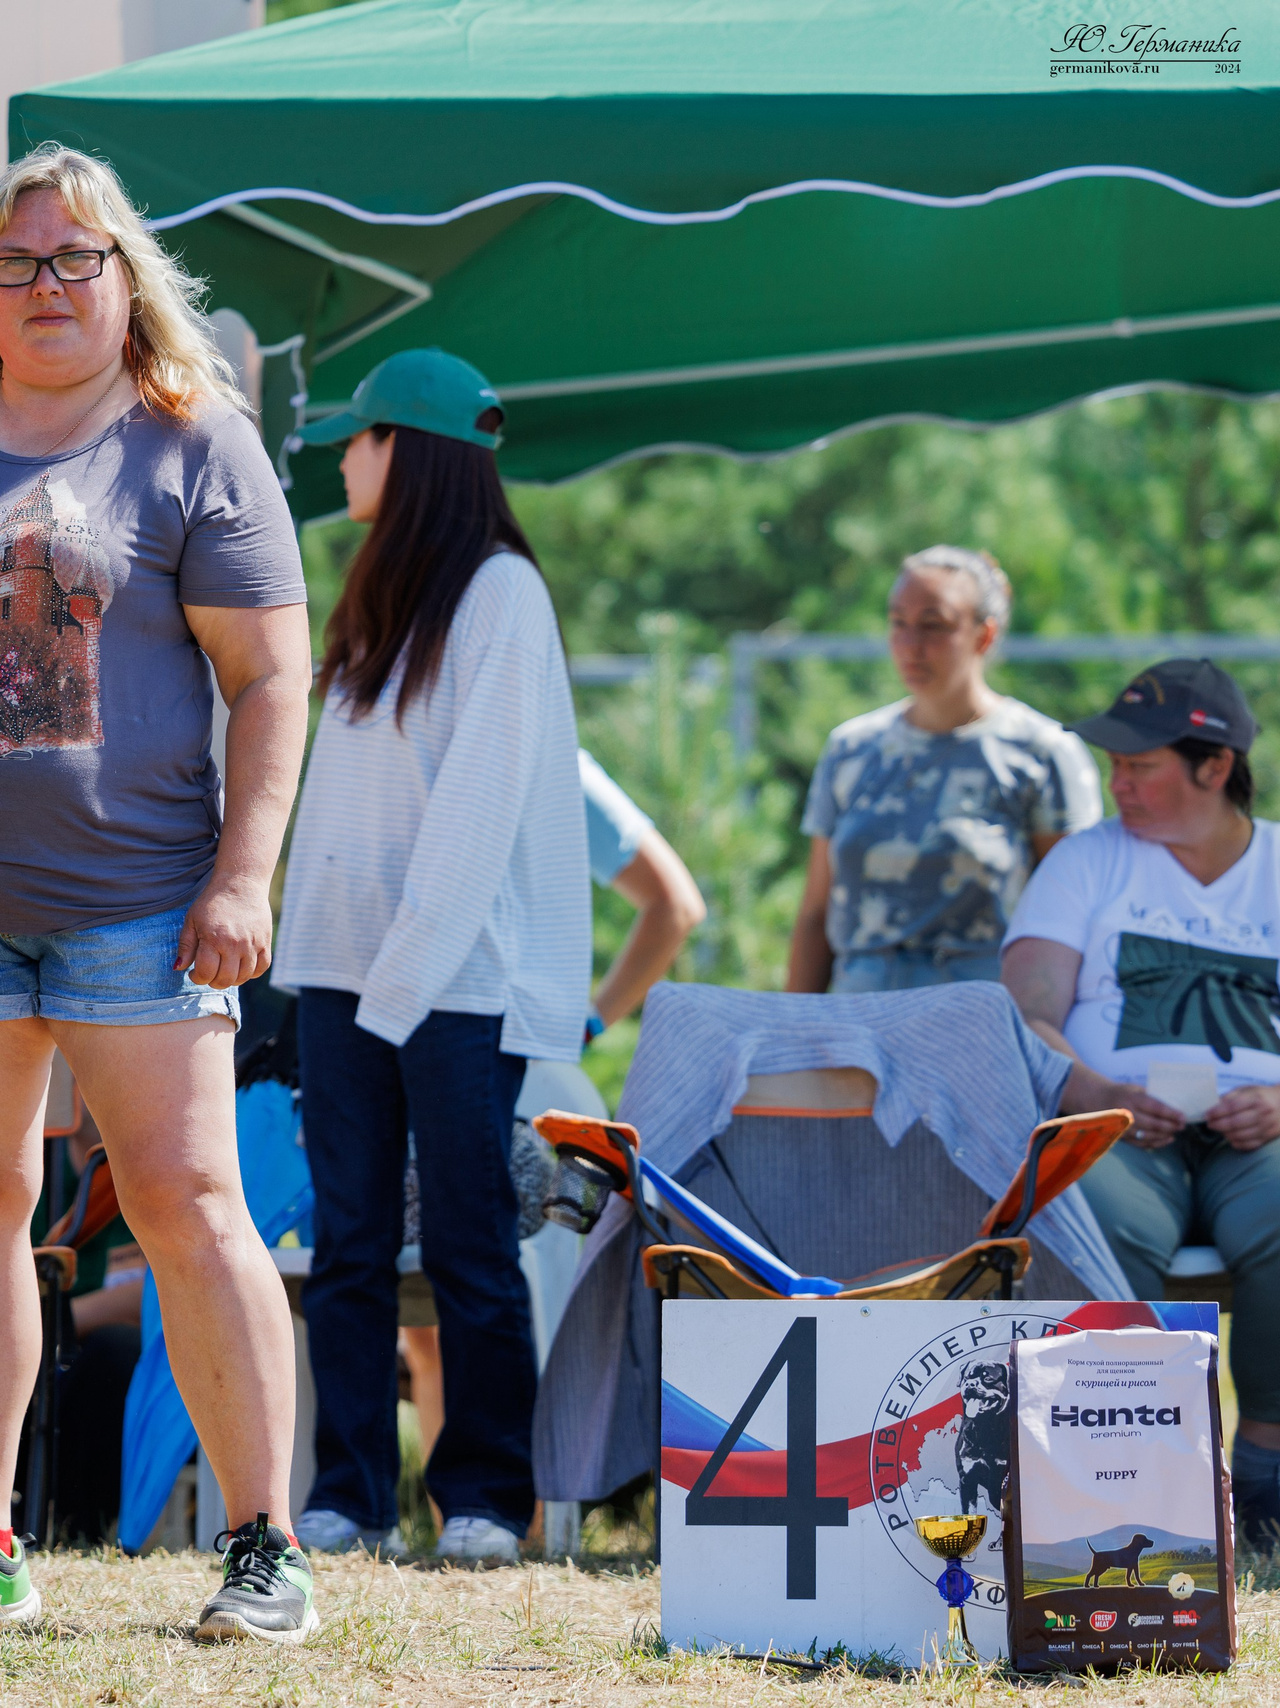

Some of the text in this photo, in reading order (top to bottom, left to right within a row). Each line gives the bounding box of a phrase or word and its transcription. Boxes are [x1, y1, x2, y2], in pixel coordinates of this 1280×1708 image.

[1067, 1358, 1085, 1366] Корм
[1081, 1378, 1120, 1388] курицей
[1128, 1379, 1157, 1388] рисом
[1051, 1405, 1181, 1427] Hanta
[875, 1325, 987, 1531] РОТВЕЙЛЕР
[1091, 1430, 1141, 1439] premium
[685, 1316, 849, 1600] 4
[1095, 1470, 1138, 1480] PUPPY
[1057, 1614, 1076, 1628] NWC
[1095, 1620, 1109, 1628] MEAT
